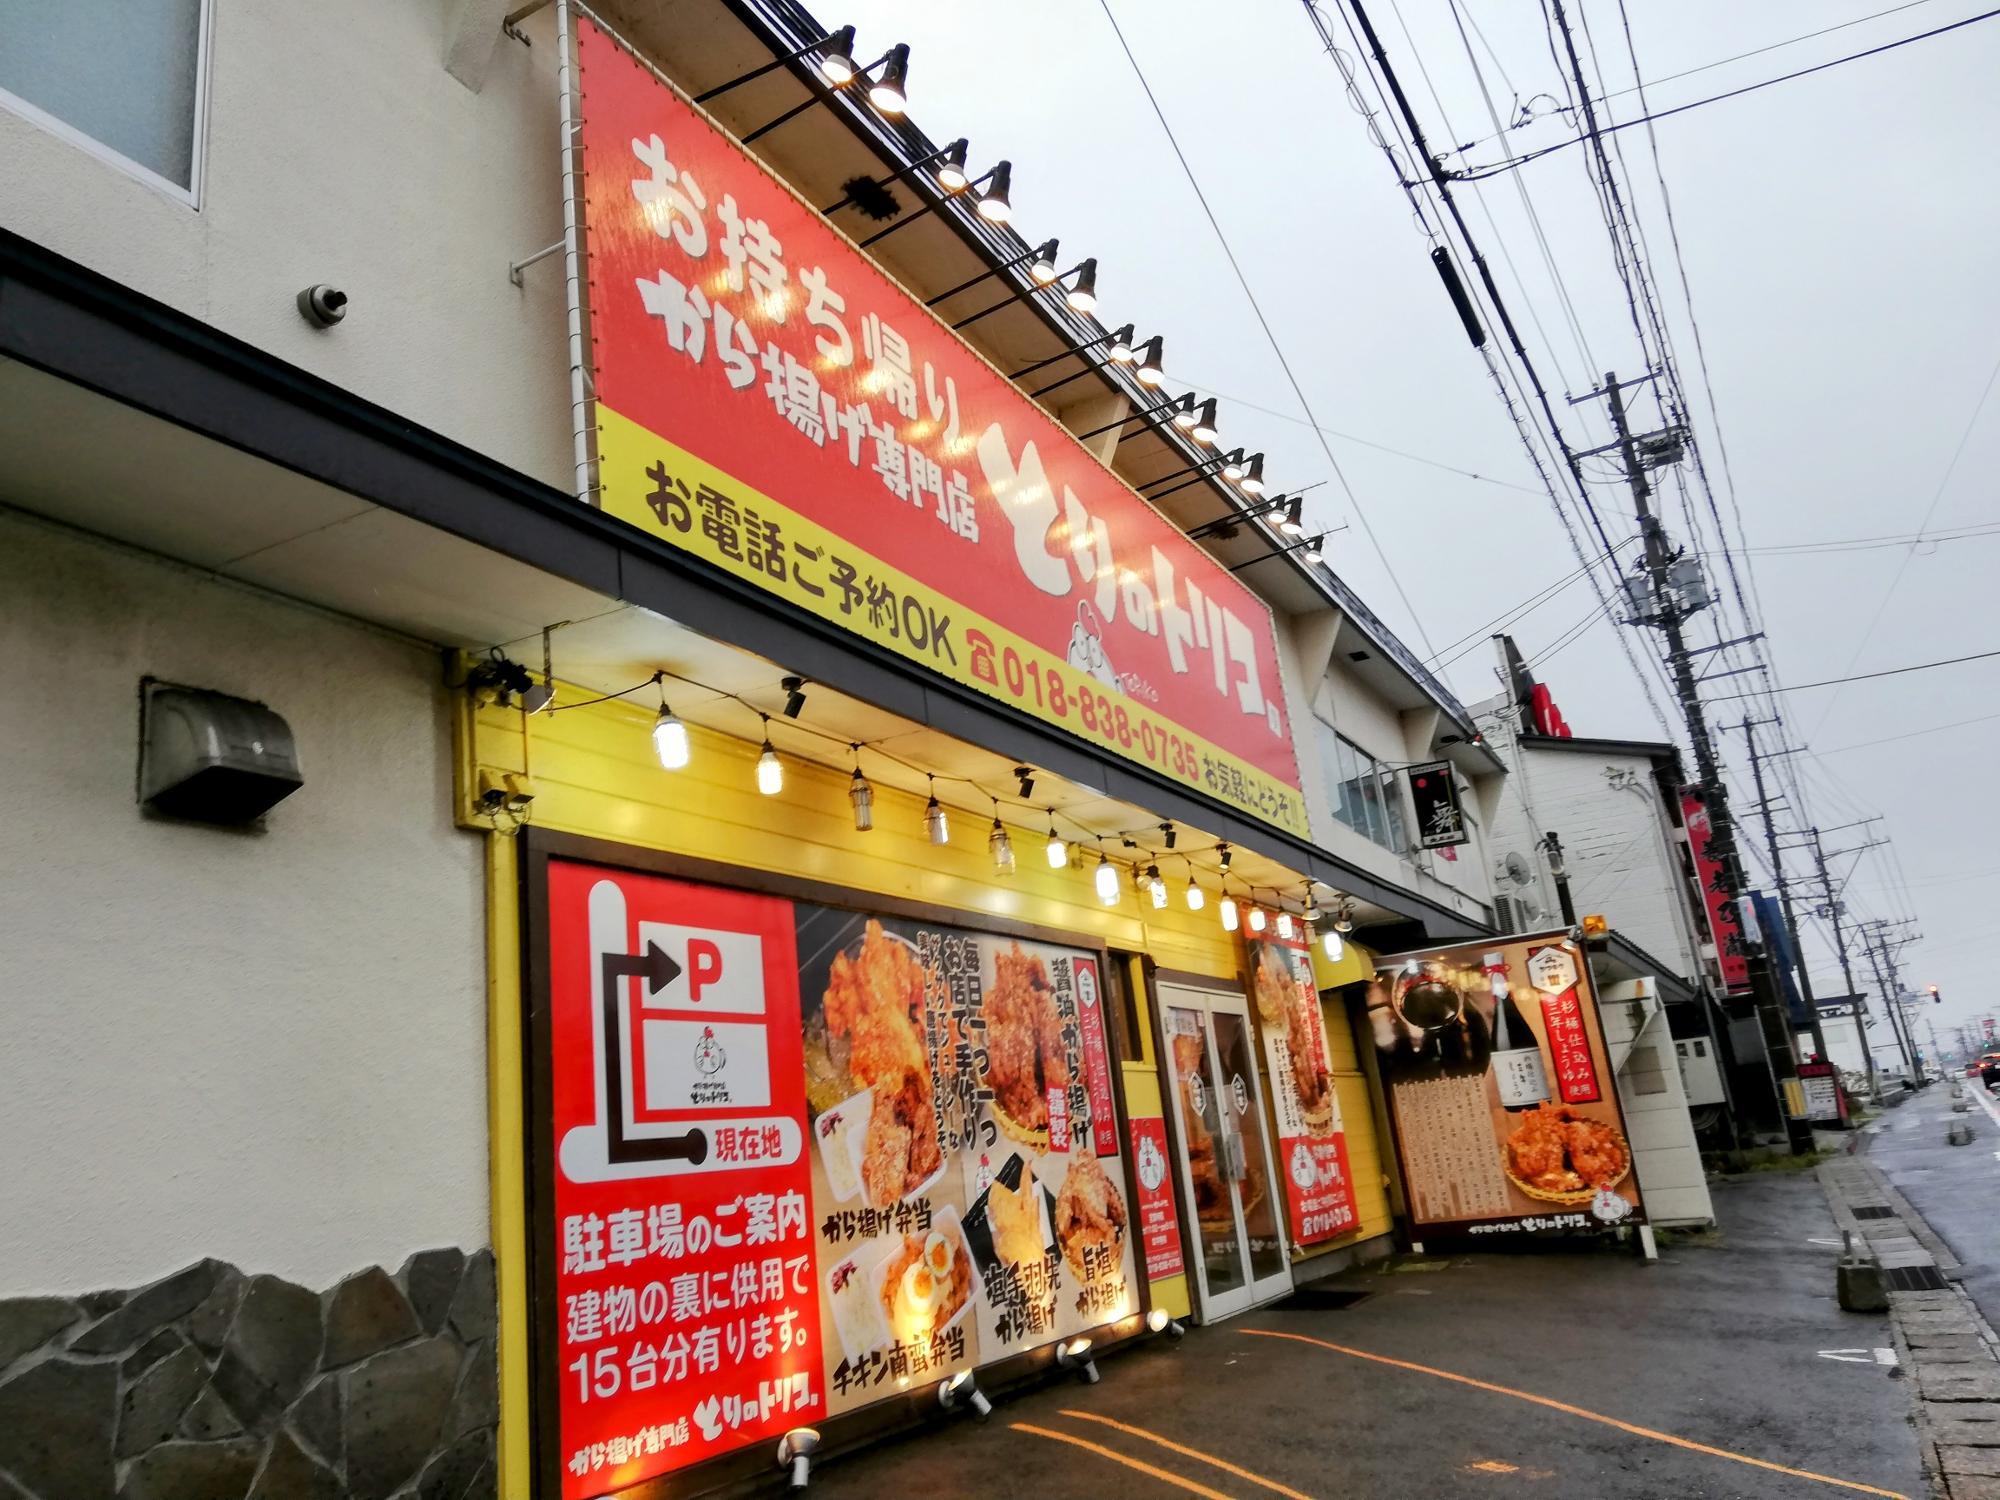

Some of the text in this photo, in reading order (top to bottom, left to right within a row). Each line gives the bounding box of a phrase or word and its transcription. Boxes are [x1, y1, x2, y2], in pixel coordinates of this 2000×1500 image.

[632, 133, 962, 444] お持ち帰り
[636, 269, 980, 544] から揚げ専門店
[645, 459, 958, 667] お電話ご予約OK
[1003, 647, 1199, 782] 018-838-0735
[687, 938, 722, 1002] P
[715, 1125, 781, 1161] 現在地
[563, 1189, 807, 1275] 駐車場のご案内
[822, 1198, 932, 1245] から揚げ弁当
[984, 1255, 1062, 1309] 塩手羽先
[1083, 1244, 1114, 1281] 旨塩
[566, 1254, 810, 1344] 建物の裏に供用で
[995, 1296, 1058, 1345] から揚げ
[1075, 1274, 1127, 1319] から揚げ
[569, 1307, 807, 1403] 15台分有ります。
[832, 1326, 965, 1396] チキン南蛮弁当
[569, 1416, 690, 1477] から揚げ専門店
